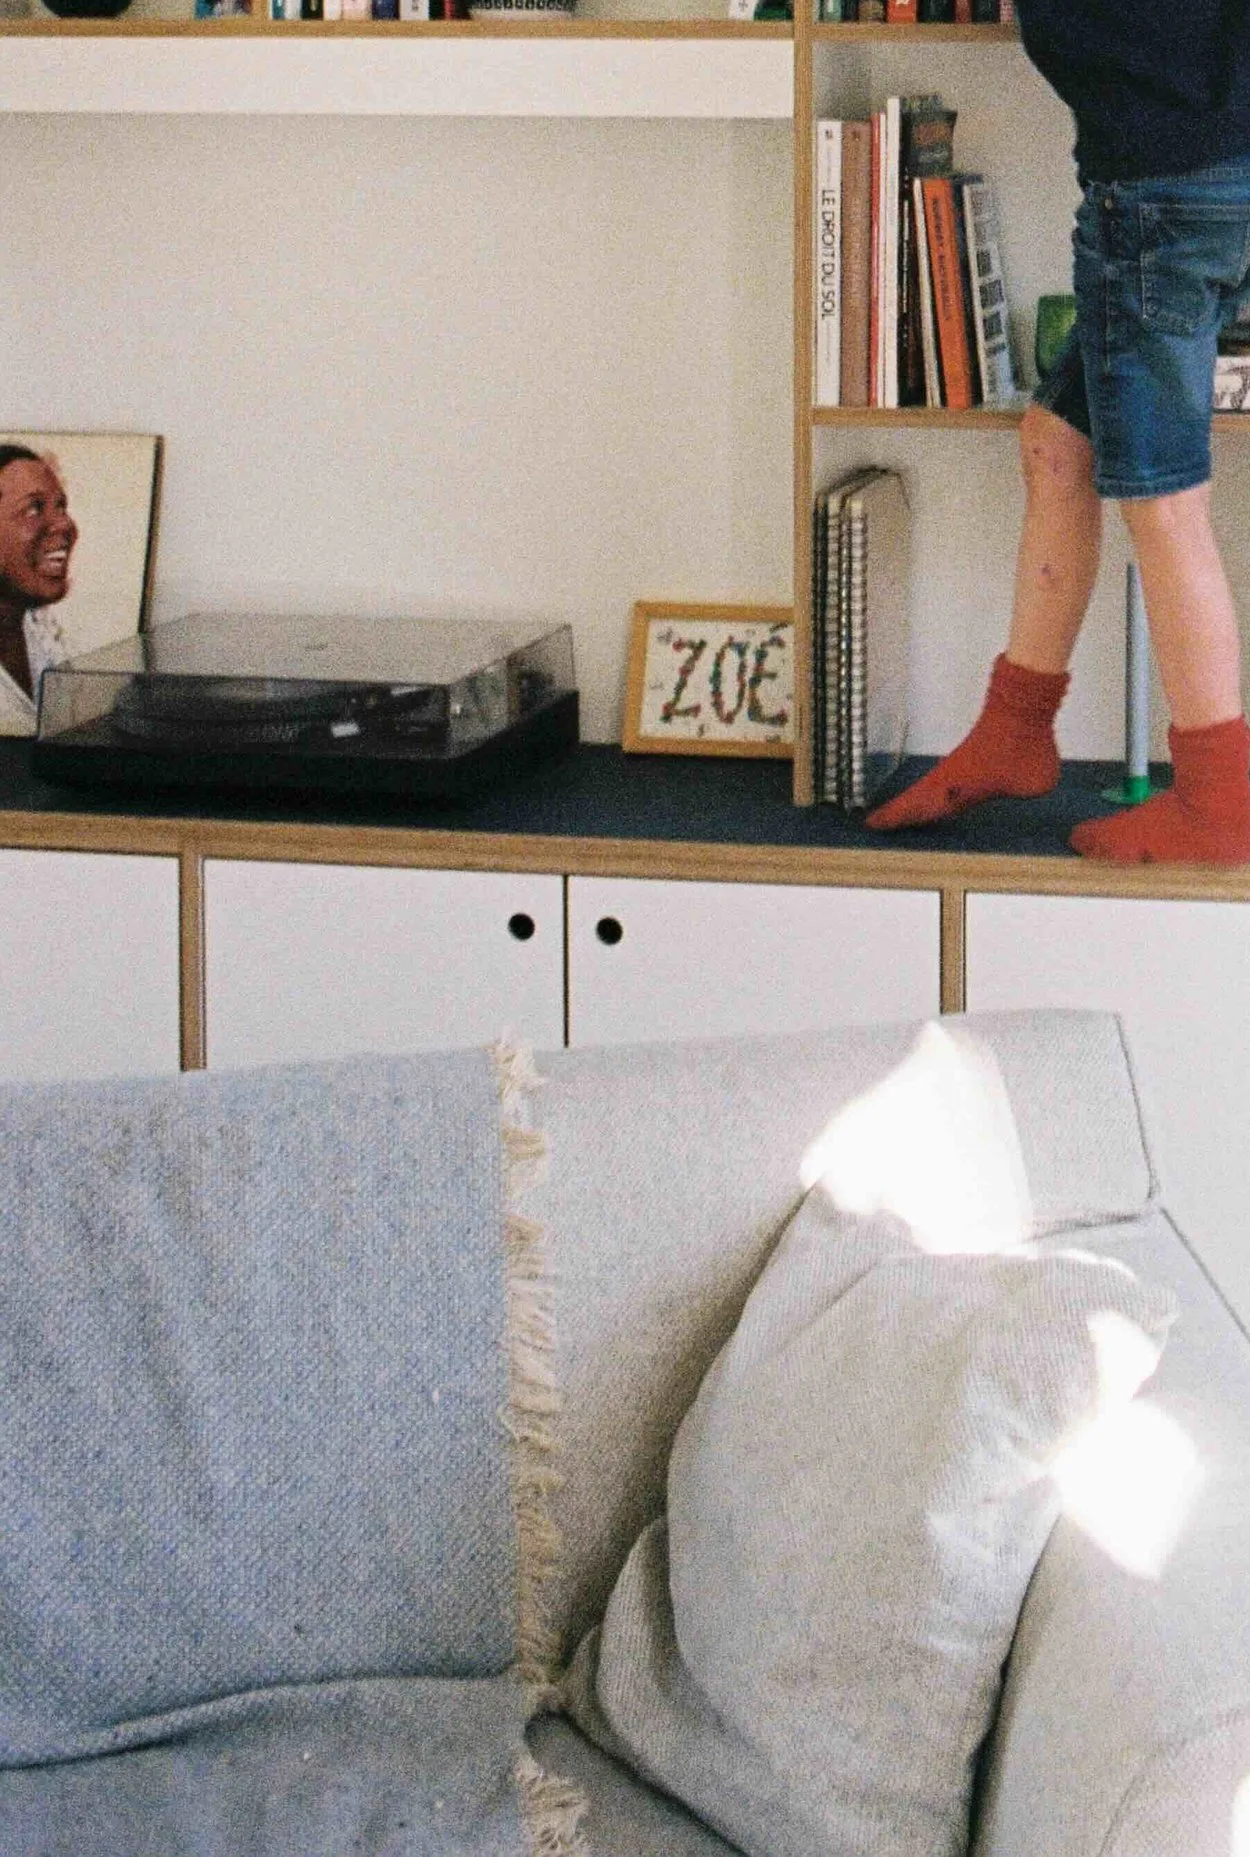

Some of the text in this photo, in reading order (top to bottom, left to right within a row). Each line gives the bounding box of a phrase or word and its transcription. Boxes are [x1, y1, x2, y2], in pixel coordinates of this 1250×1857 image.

[820, 189, 835, 320] LE DROIT DU SOL
